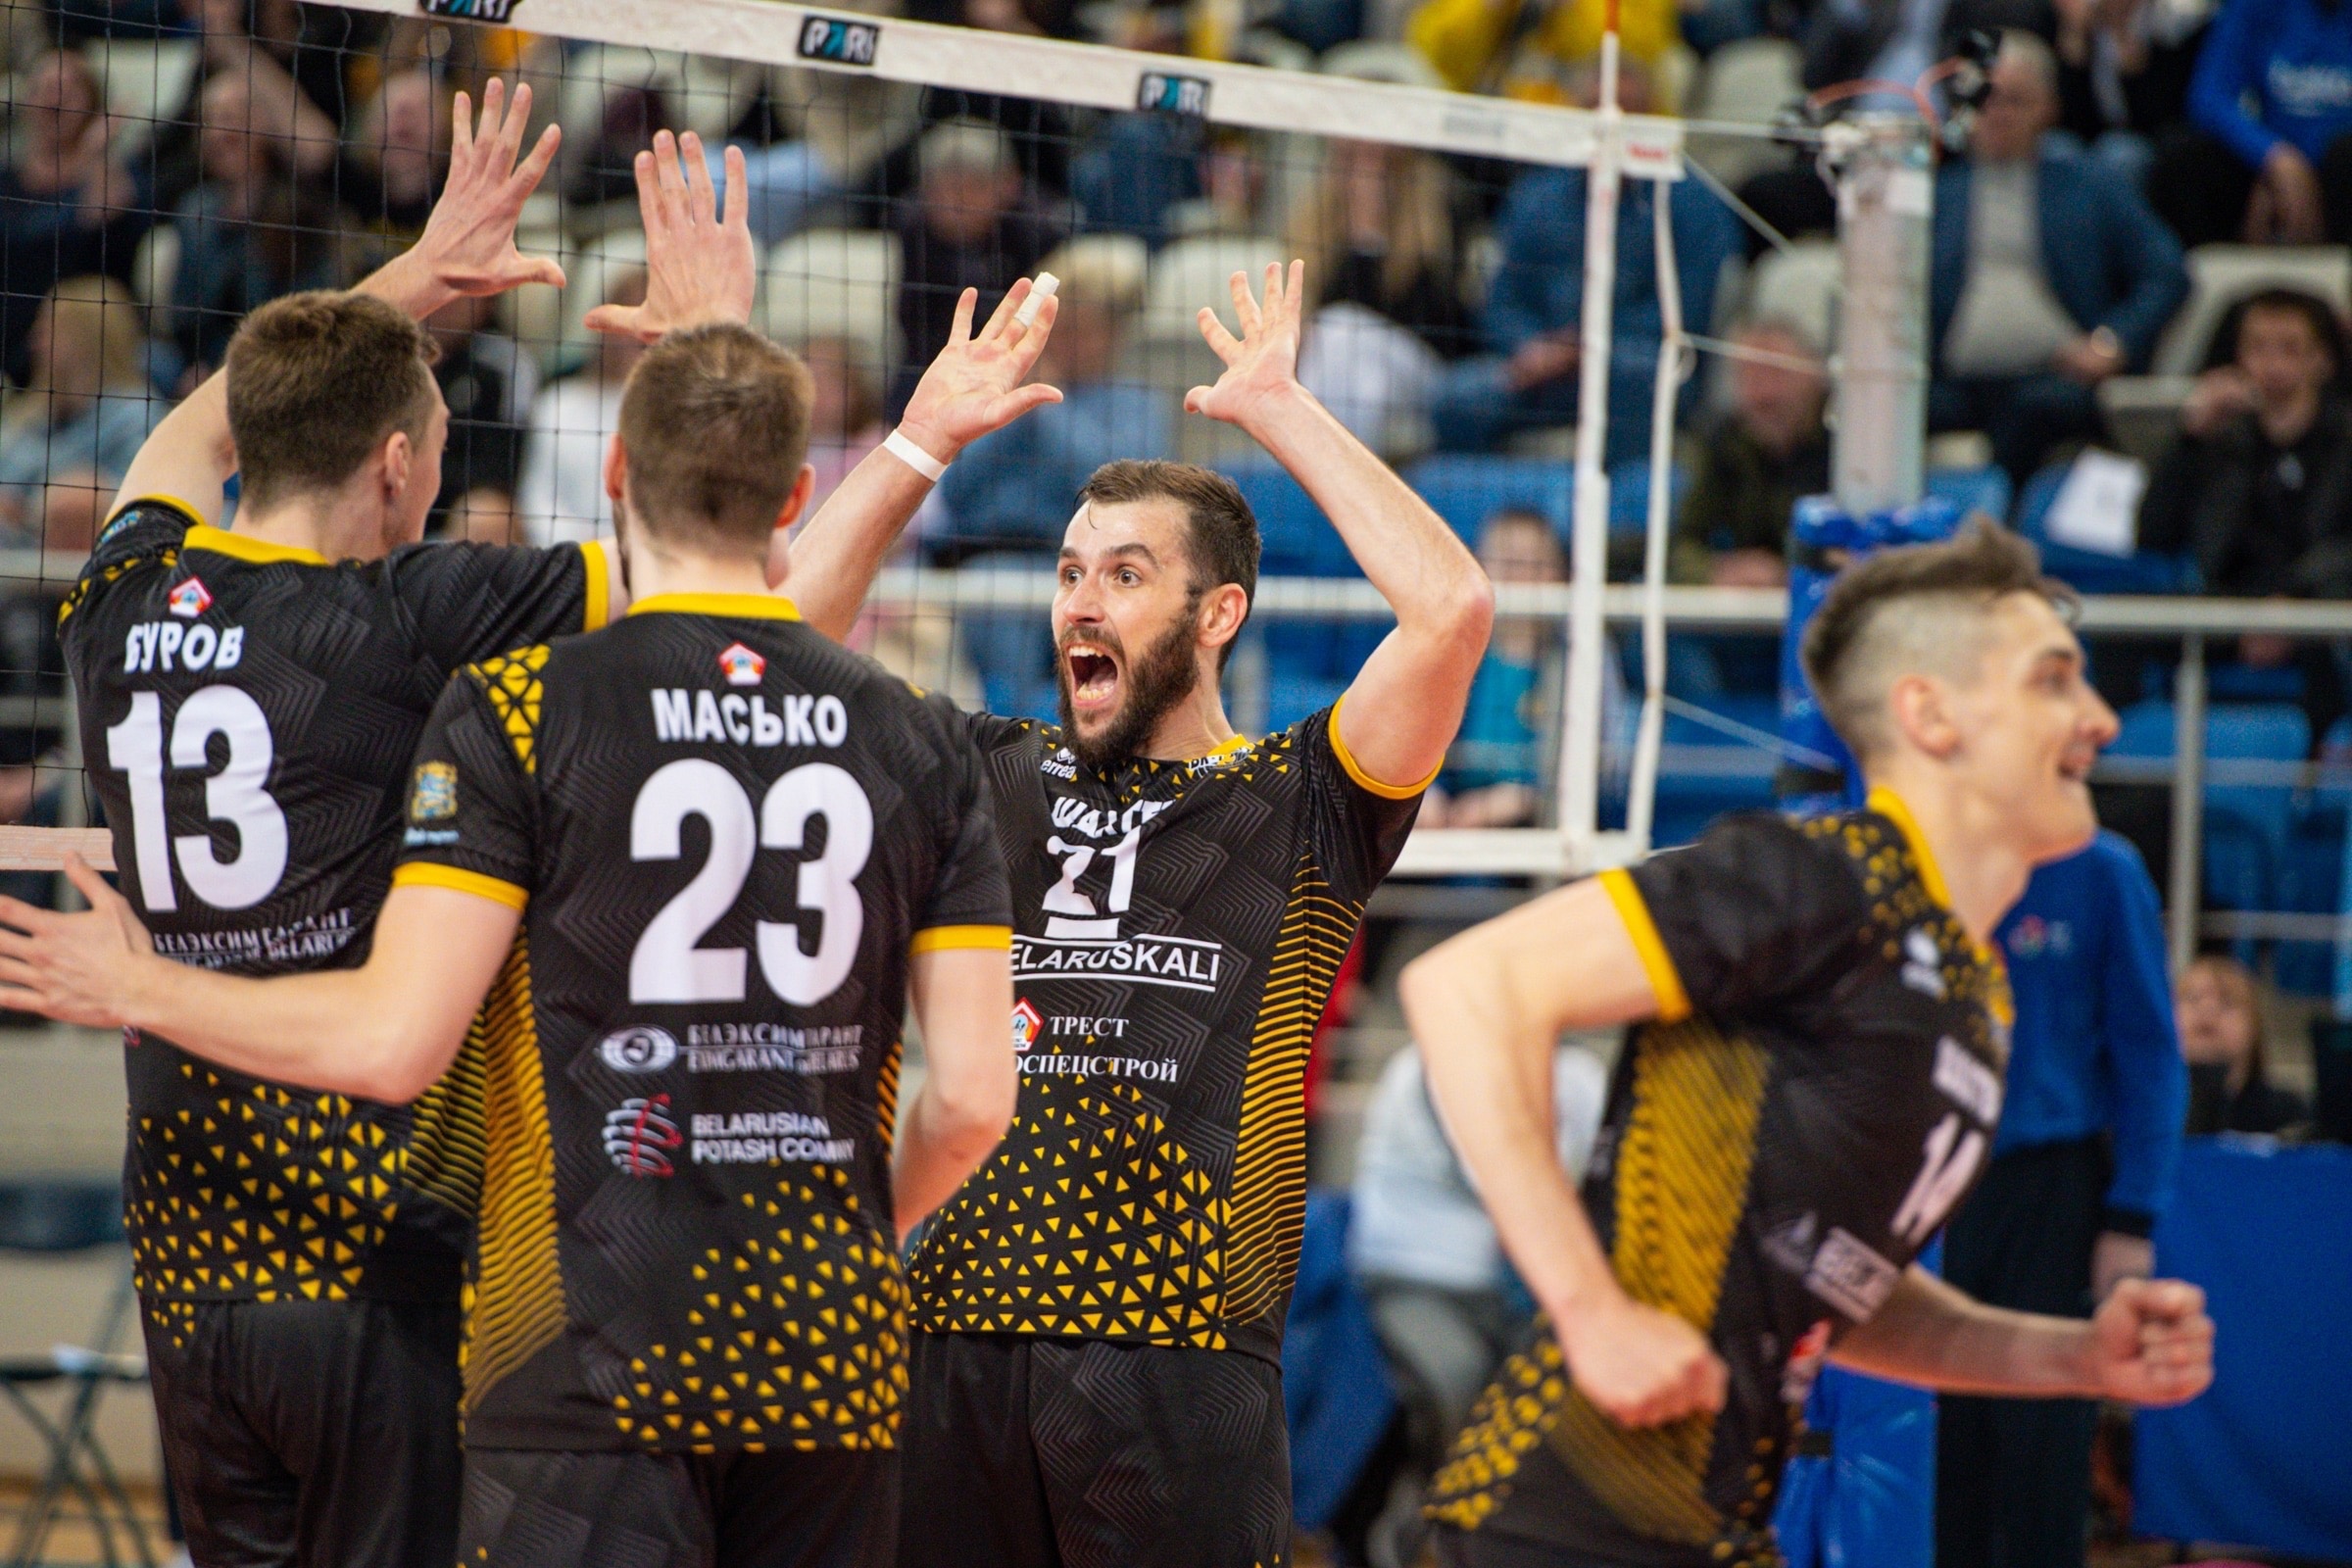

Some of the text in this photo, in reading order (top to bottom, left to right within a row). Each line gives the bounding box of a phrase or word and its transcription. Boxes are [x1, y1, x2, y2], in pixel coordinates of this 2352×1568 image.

[123, 620, 244, 673] БУРОВ
[651, 688, 848, 748] МАСЬКО
[106, 684, 289, 912] 13
[628, 758, 875, 1007] 23
[1041, 825, 1142, 915] 21
[1010, 942, 1220, 982] ELARUSKALI
[1050, 1015, 1130, 1039] ТРЕСТ
[691, 1112, 831, 1139] BELARUSIAN
[691, 1138, 778, 1164] POTASH
